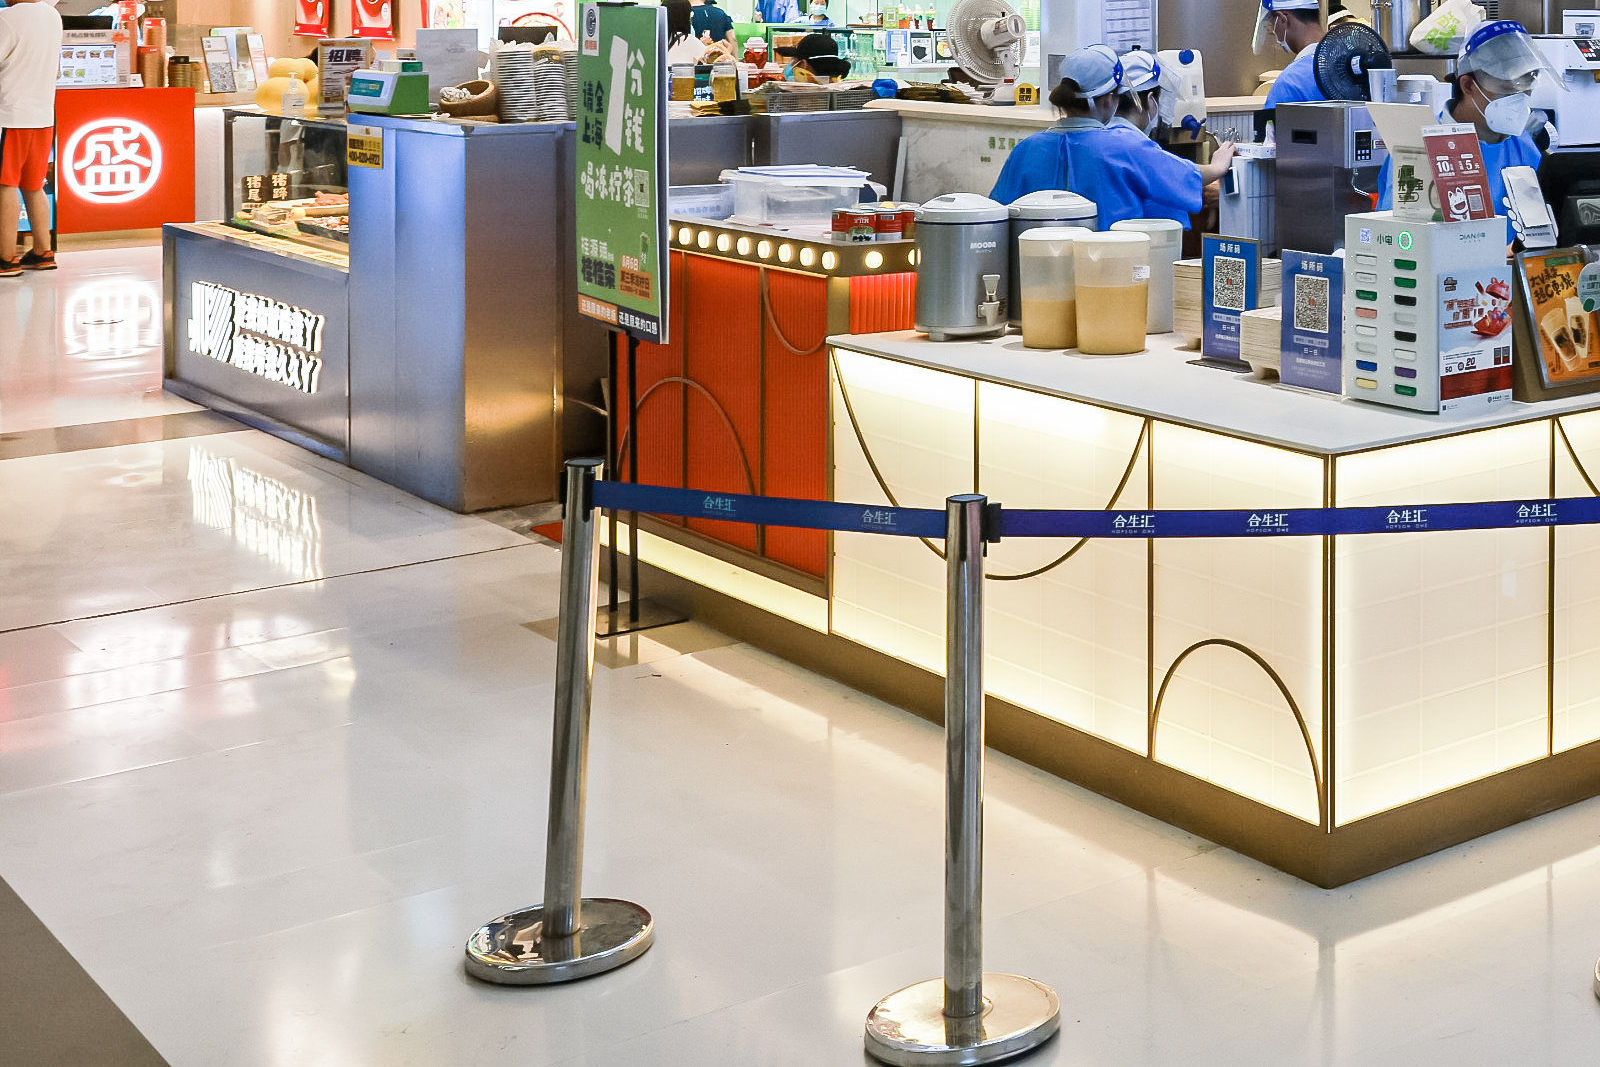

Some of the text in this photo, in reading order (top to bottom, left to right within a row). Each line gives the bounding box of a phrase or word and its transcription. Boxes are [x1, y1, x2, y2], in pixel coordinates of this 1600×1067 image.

[328, 49, 362, 62] 招聘
[582, 115, 603, 150] 上海
[73, 127, 152, 193] 盛
[1465, 160, 1473, 170] 5
[246, 175, 262, 201] 猪尾
[581, 161, 635, 208] 喝冻柠茶
[1377, 234, 1393, 246] 小电
[1219, 242, 1241, 255] 场所码
[621, 254, 639, 271] 8月6日
[1301, 260, 1324, 273] 场所码
[581, 255, 616, 290] 桂桂茶
[619, 311, 658, 335] 还是原来的口感
[1444, 365, 1453, 373] 50
[1466, 357, 1476, 366] 20
[703, 495, 737, 512] 合生汇
[1516, 503, 1558, 518] 合生汇
[861, 509, 897, 526] 合生汇
[1113, 514, 1155, 528] 合生汇
[1247, 513, 1289, 527] 合生汇
[1386, 509, 1428, 524] 合生汇
